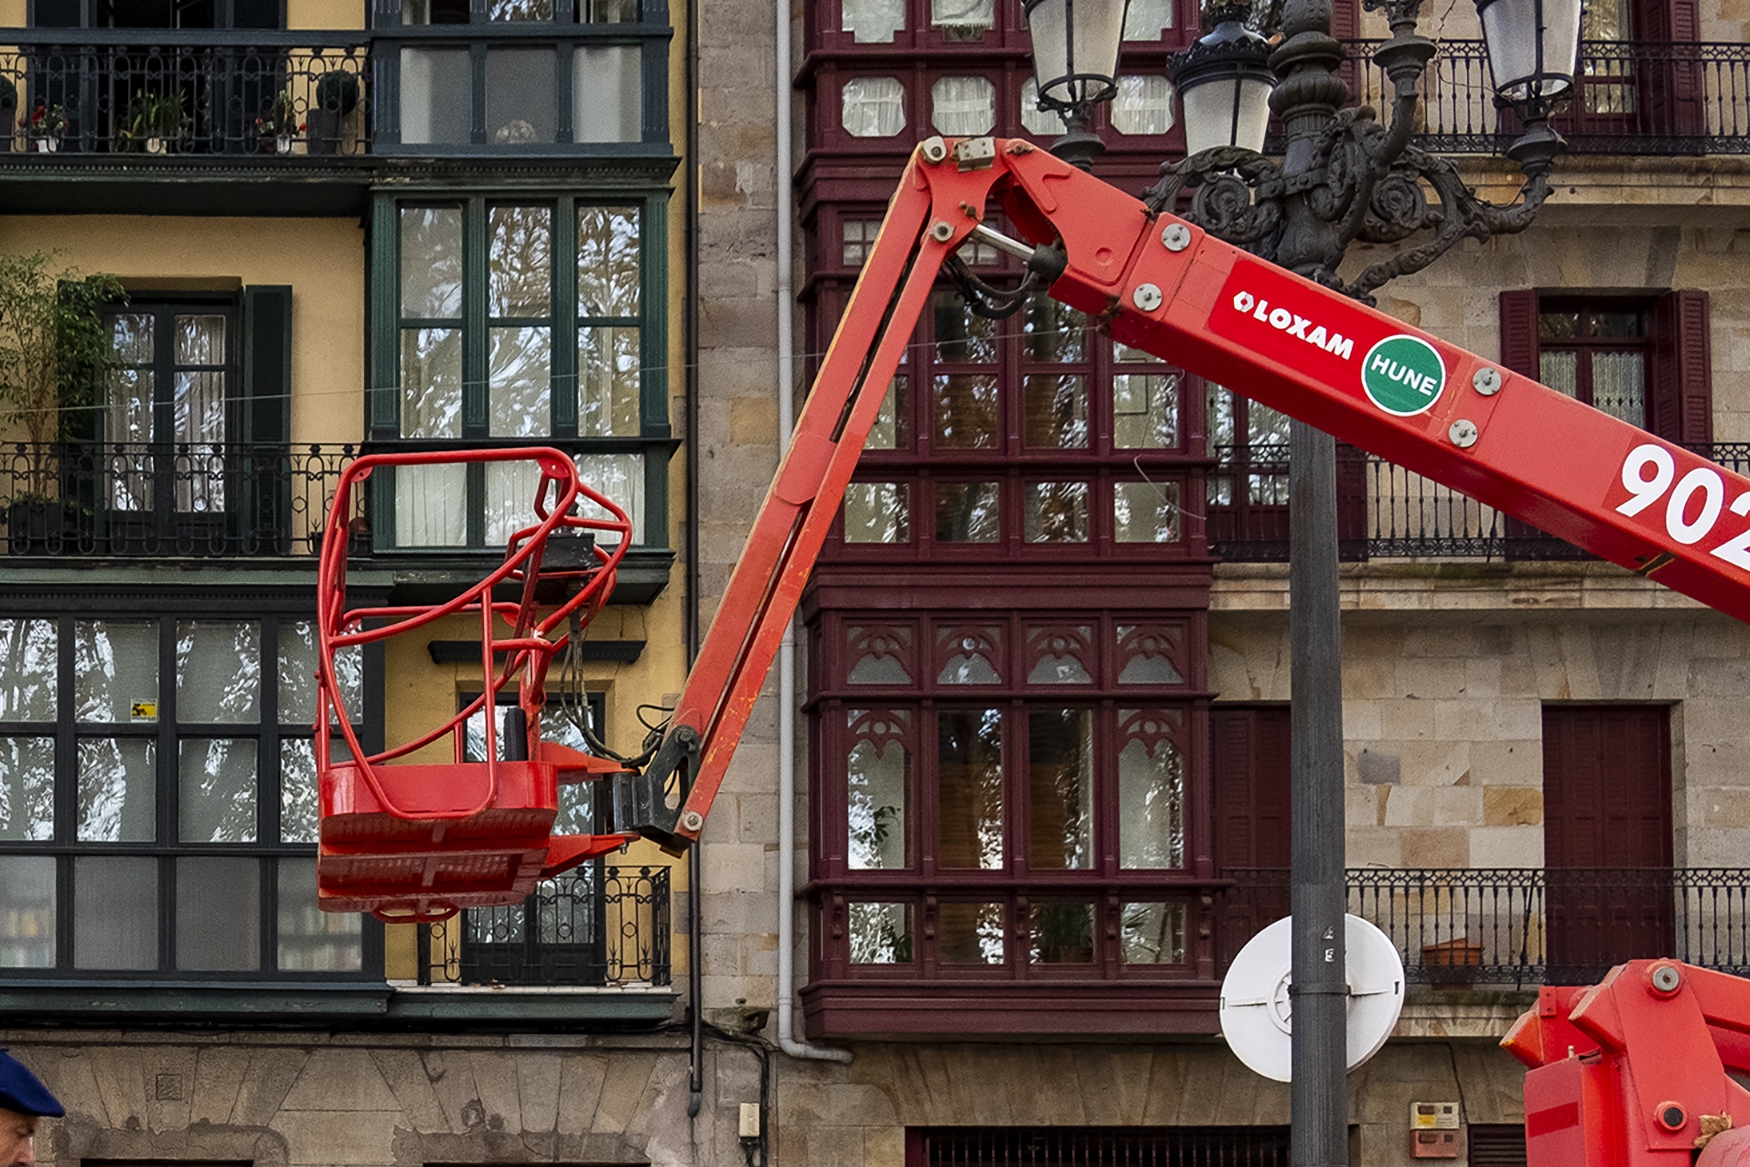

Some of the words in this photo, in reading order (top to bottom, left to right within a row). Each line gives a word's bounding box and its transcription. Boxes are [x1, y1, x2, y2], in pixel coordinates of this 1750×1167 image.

[1253, 299, 1354, 361] LOXAM
[1370, 353, 1438, 397] HUNE
[1615, 443, 1750, 573] 902
